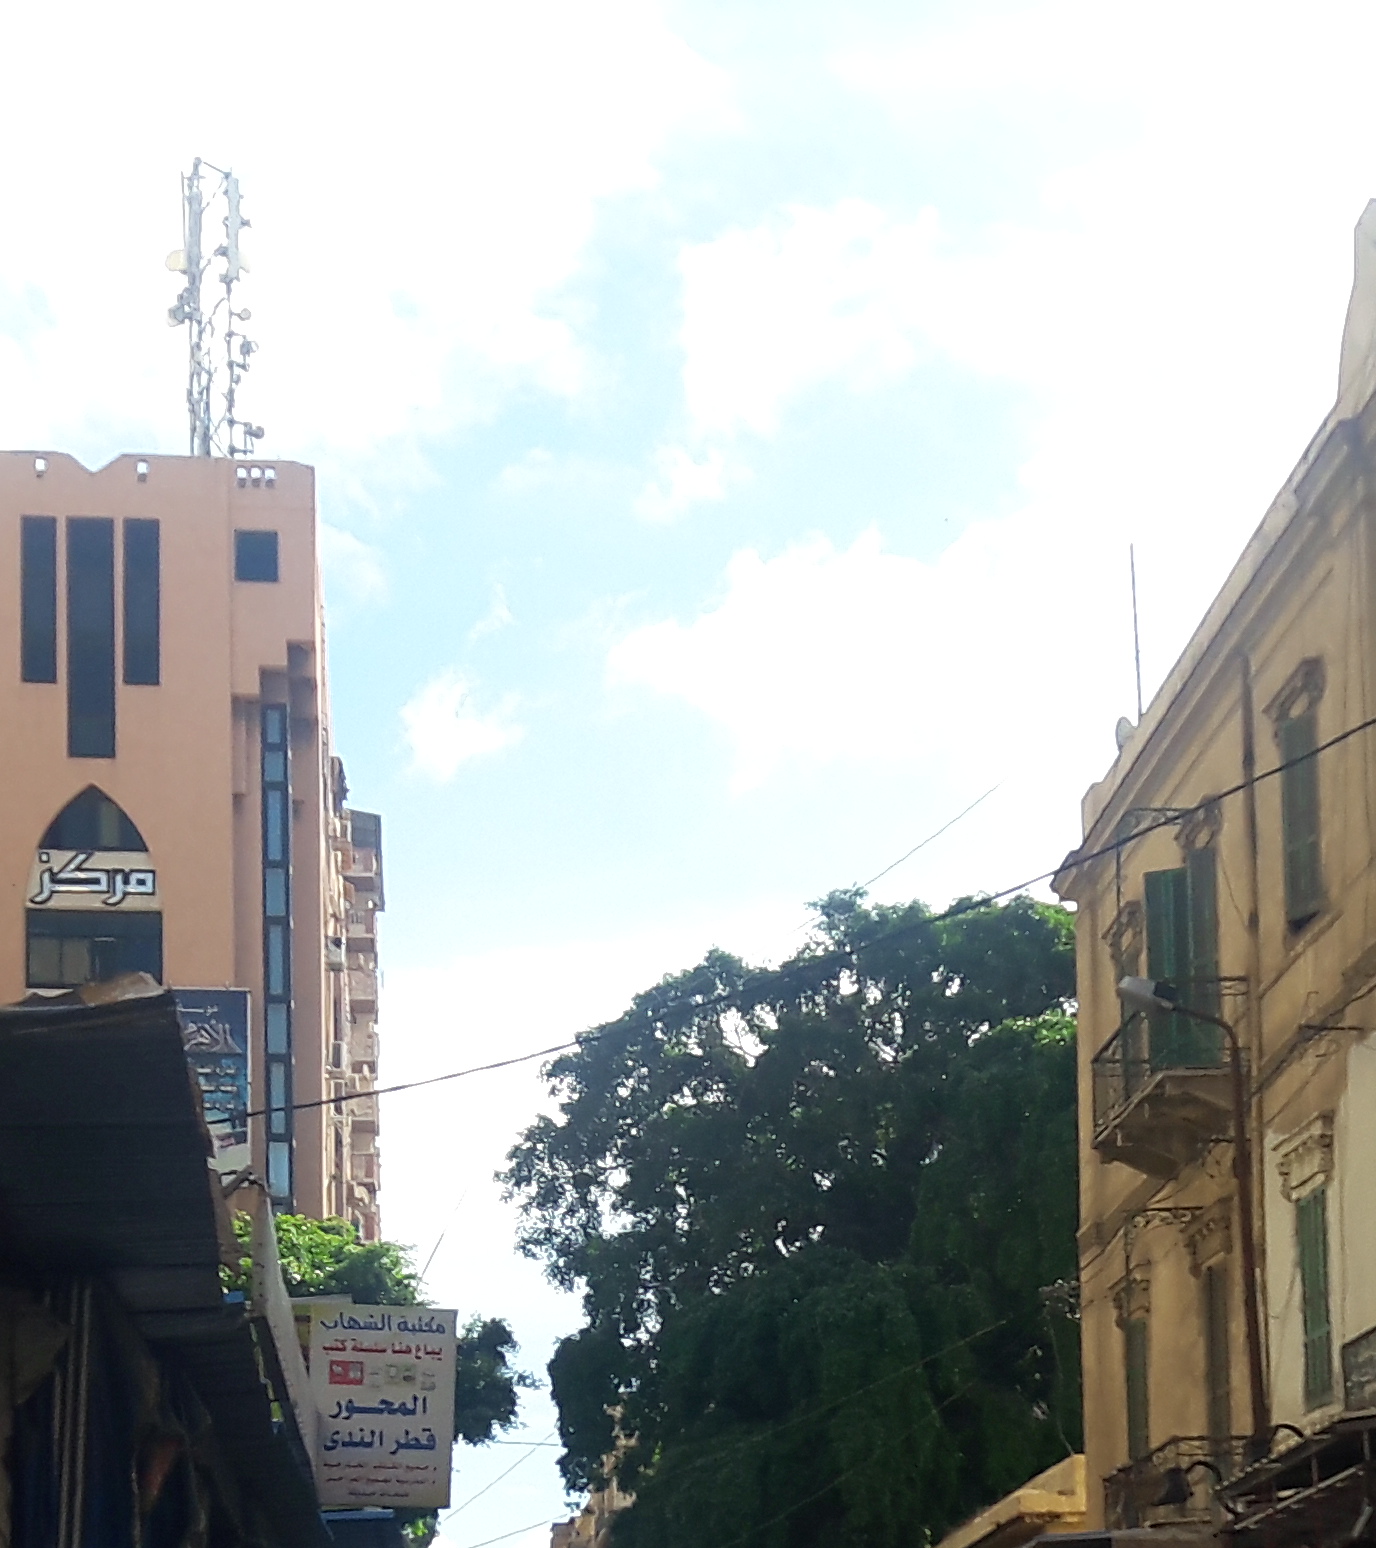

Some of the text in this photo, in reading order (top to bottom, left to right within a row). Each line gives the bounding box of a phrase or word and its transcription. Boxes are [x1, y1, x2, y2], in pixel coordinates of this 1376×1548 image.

[28, 850, 157, 906] مركز
[320, 1311, 446, 1334] مكتبة الشهاب
[391, 1341, 412, 1355] هنا
[327, 1393, 427, 1420] المحور
[323, 1427, 437, 1455] قطر الندى
